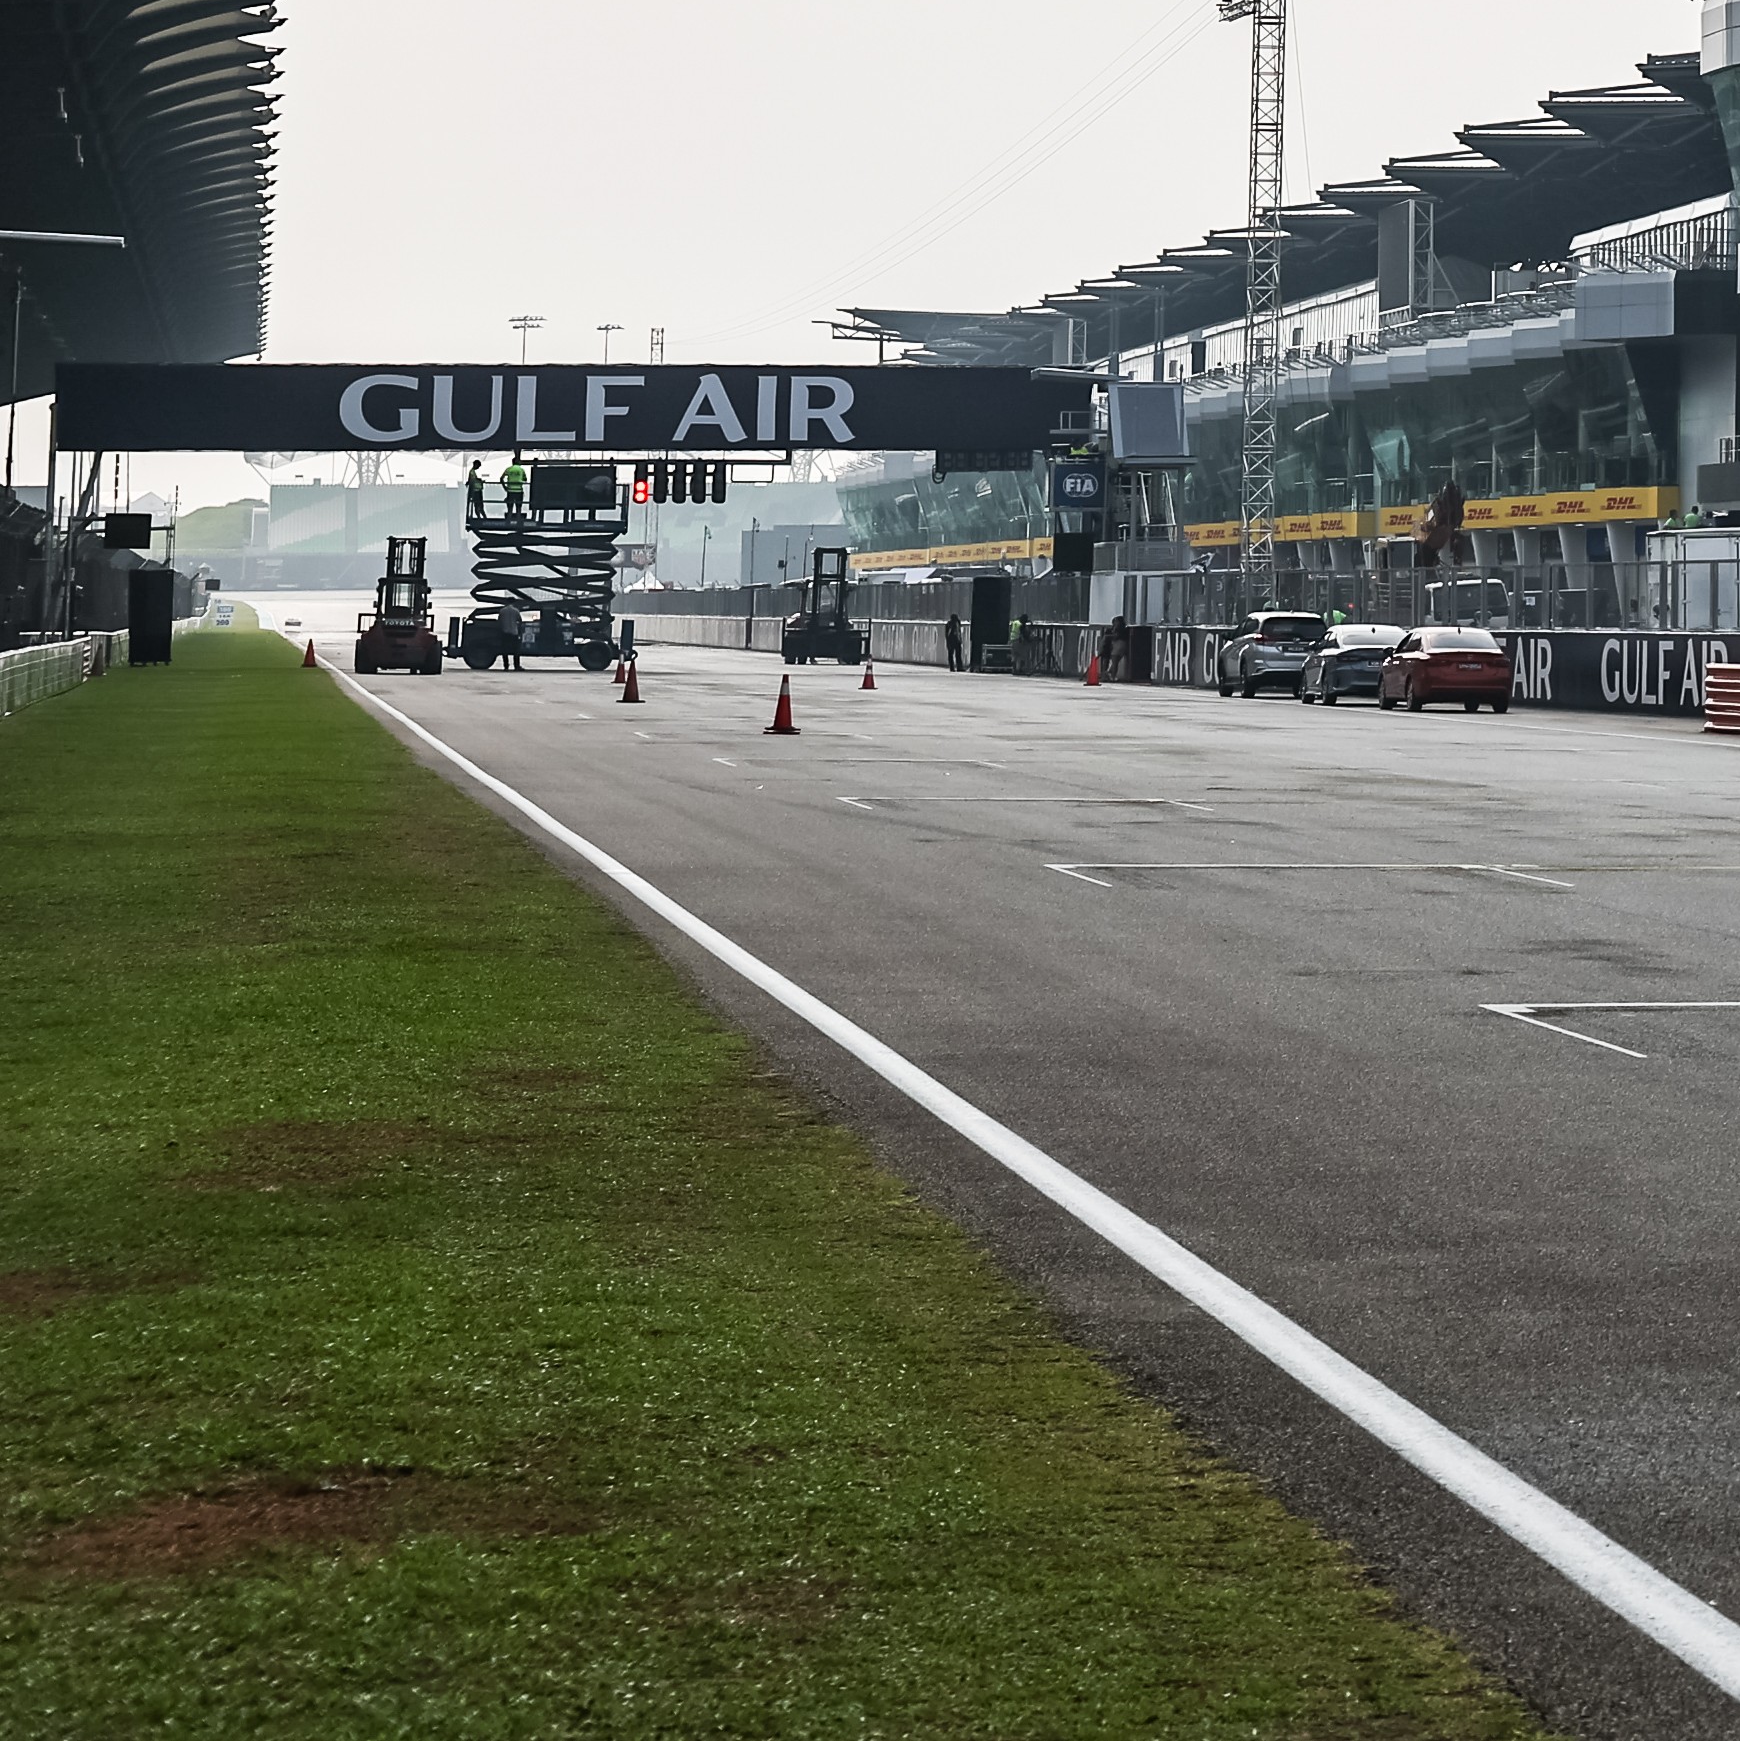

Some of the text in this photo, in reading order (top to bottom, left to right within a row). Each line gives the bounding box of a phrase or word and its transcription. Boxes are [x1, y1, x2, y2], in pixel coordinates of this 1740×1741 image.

[339, 373, 856, 442] GULF AIR
[1555, 501, 1586, 513] DHL
[1606, 496, 1636, 509] DHL
[1467, 507, 1494, 520] DHL
[1510, 504, 1538, 517] DHL
[1319, 520, 1342, 530] DHL
[1162, 630, 1191, 682] AIR
[1512, 636, 1552, 700] AIR
[1601, 638, 1674, 705] GULF
